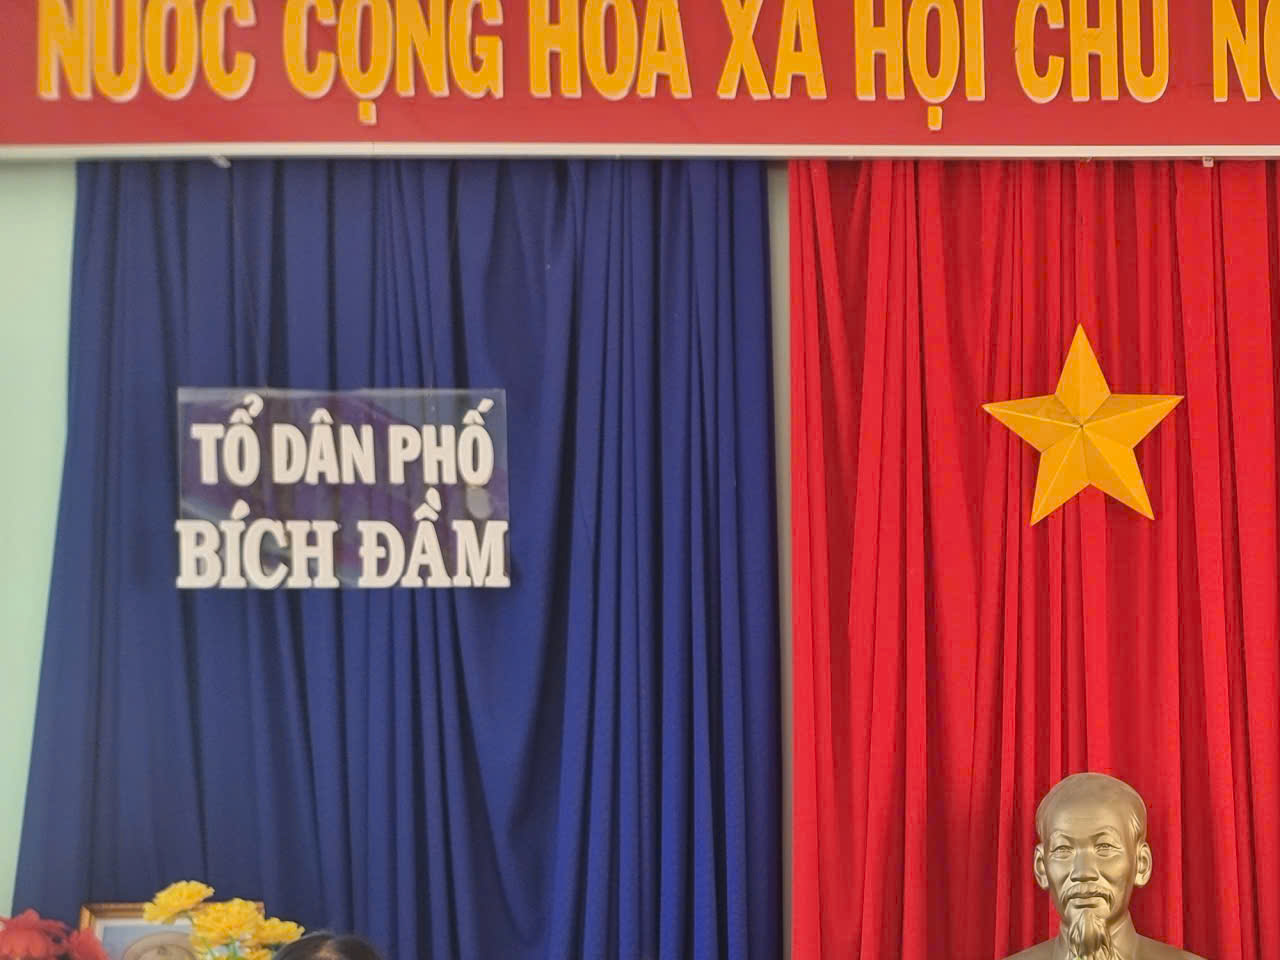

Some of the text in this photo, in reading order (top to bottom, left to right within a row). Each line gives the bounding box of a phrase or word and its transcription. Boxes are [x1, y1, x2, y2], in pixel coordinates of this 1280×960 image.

[191, 393, 494, 487] TỔ DÂN PHỐ
[175, 487, 511, 589] BÍCH ĐẦM
